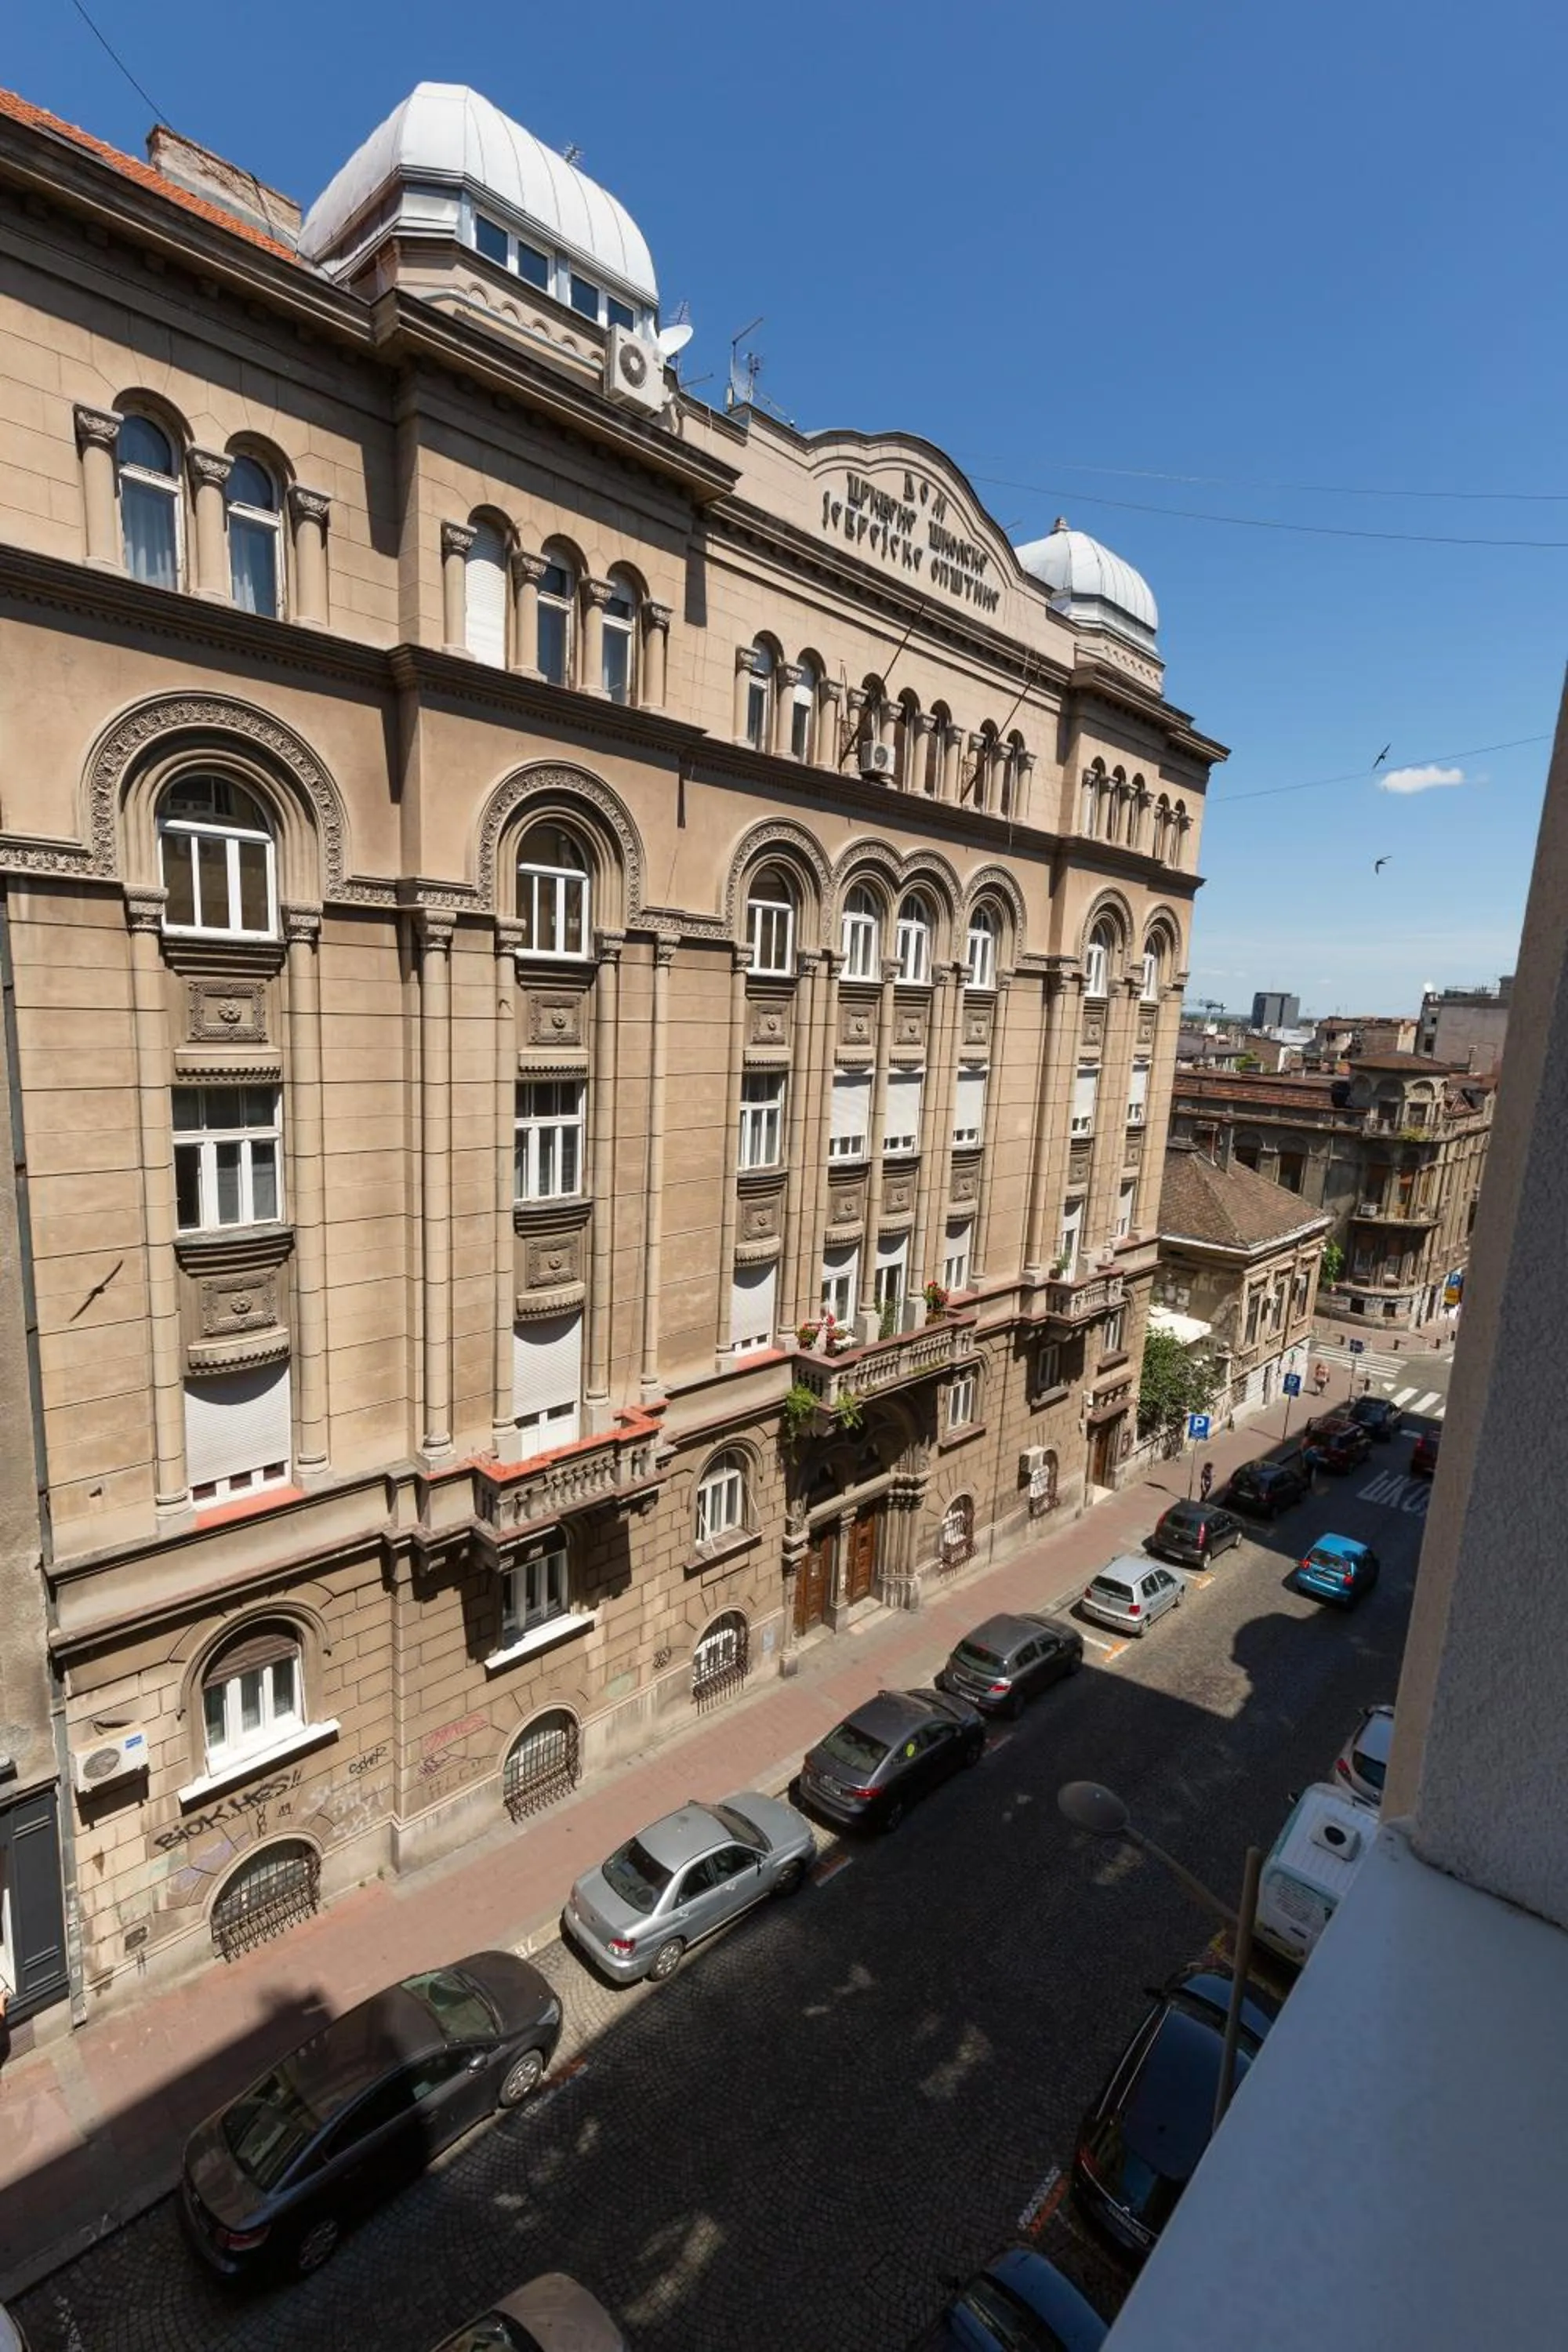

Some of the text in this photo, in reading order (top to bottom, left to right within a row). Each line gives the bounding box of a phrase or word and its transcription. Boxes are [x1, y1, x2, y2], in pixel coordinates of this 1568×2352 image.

[903, 470, 948, 524] ДОМ
[928, 520, 989, 577] ШКОЛСКЕ
[931, 557, 1000, 615] ОПШТИНЕ
[1193, 1417, 1205, 1431] P
[1356, 1470, 1432, 1517] ШКО
